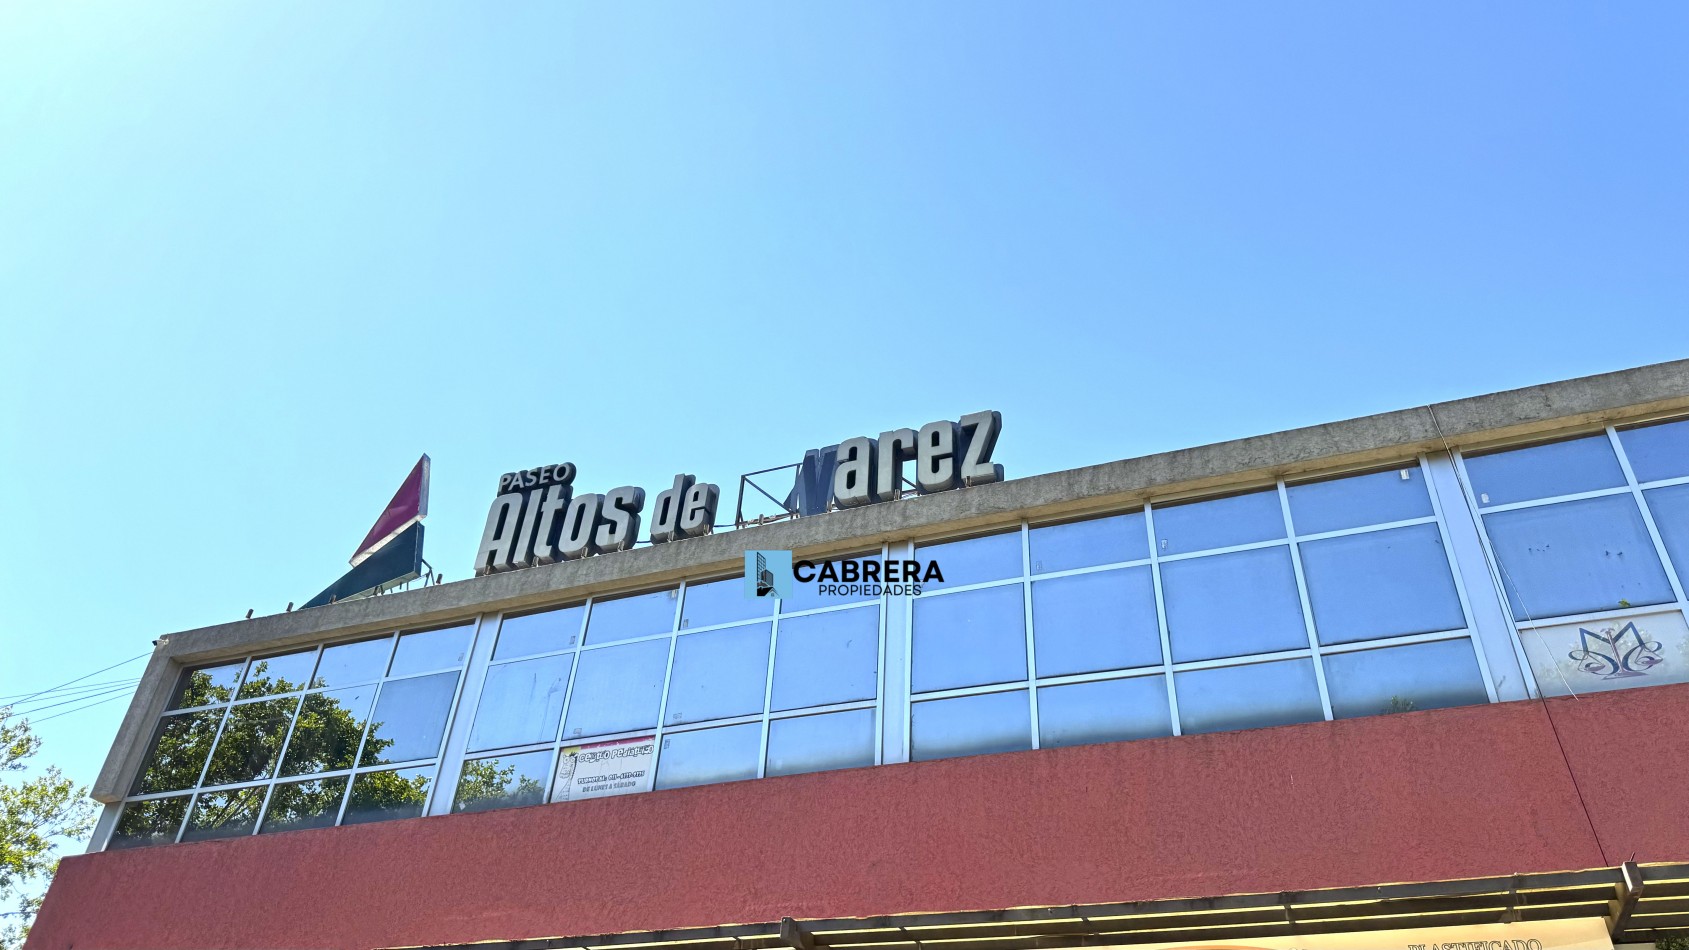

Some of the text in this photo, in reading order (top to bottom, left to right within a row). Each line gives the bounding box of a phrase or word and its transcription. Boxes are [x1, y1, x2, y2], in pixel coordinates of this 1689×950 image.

[498, 462, 574, 493] PASEO
[474, 484, 641, 574] Altos
[651, 473, 717, 541] de
